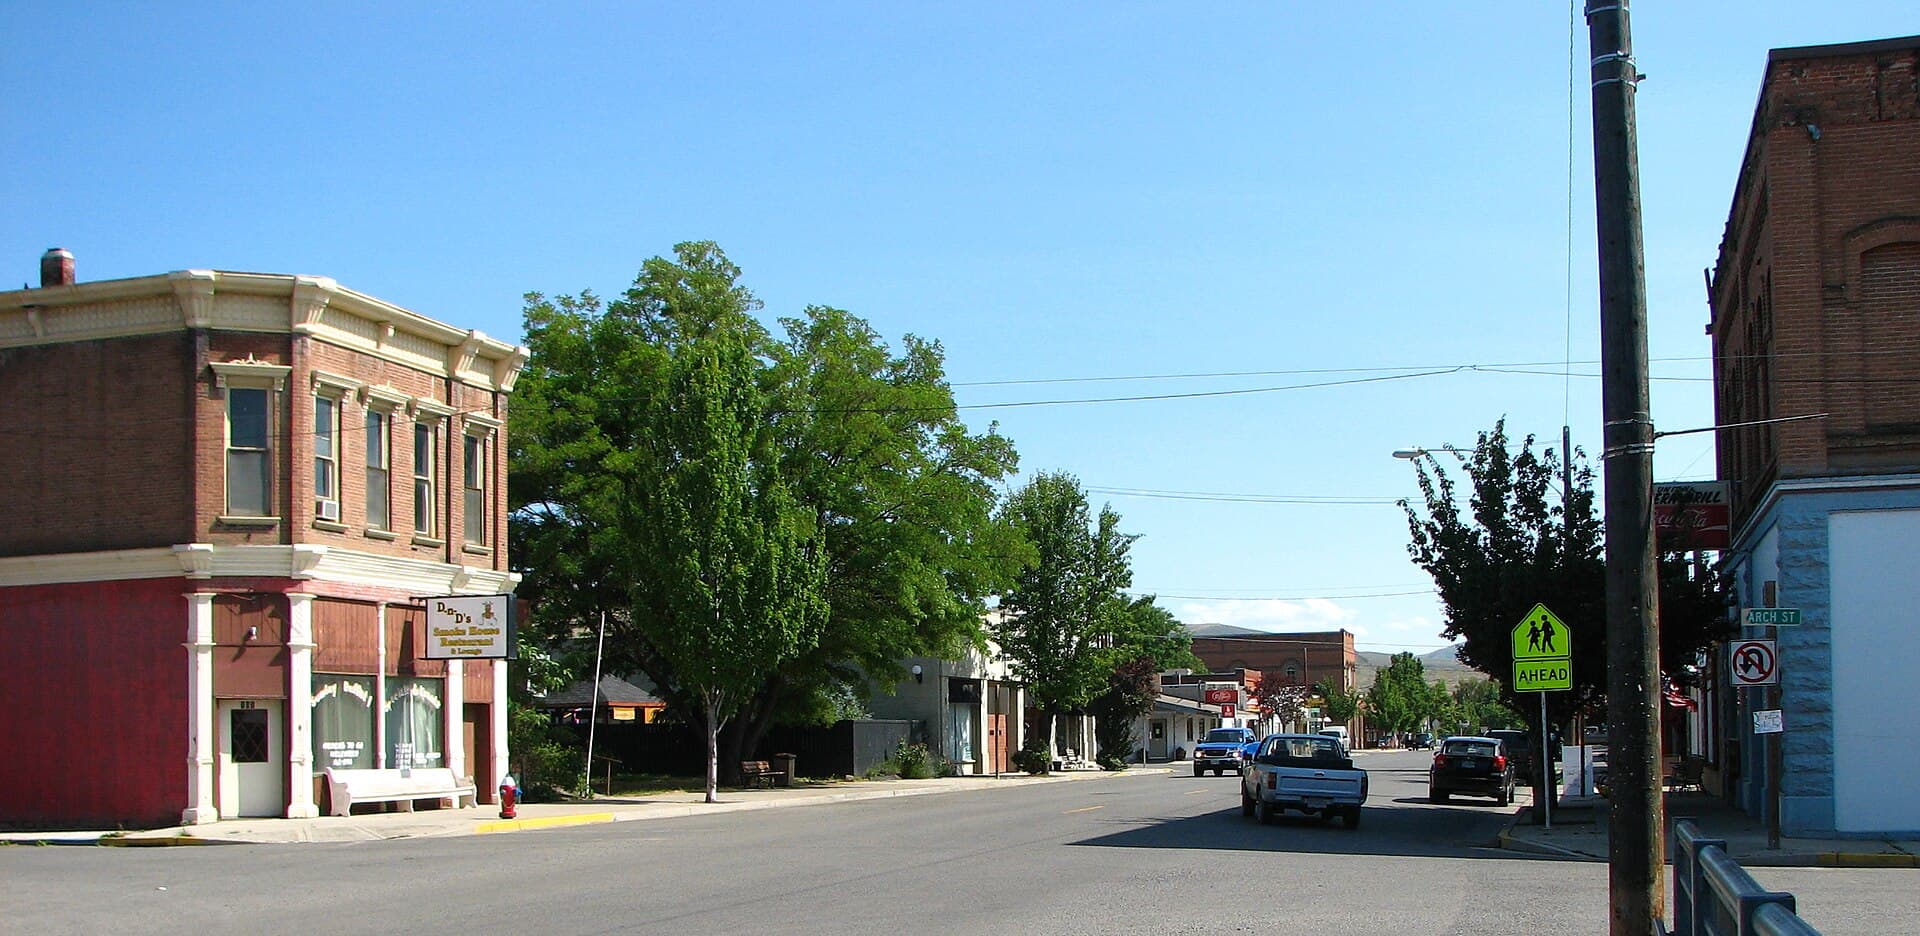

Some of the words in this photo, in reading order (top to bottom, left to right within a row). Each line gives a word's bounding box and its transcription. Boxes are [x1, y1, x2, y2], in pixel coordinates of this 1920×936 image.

[1747, 611, 1777, 622] ARCH
[1782, 611, 1795, 622] ST
[469, 626, 500, 635] House
[440, 638, 494, 647] Restaurant
[1518, 668, 1568, 682] AHEAD
